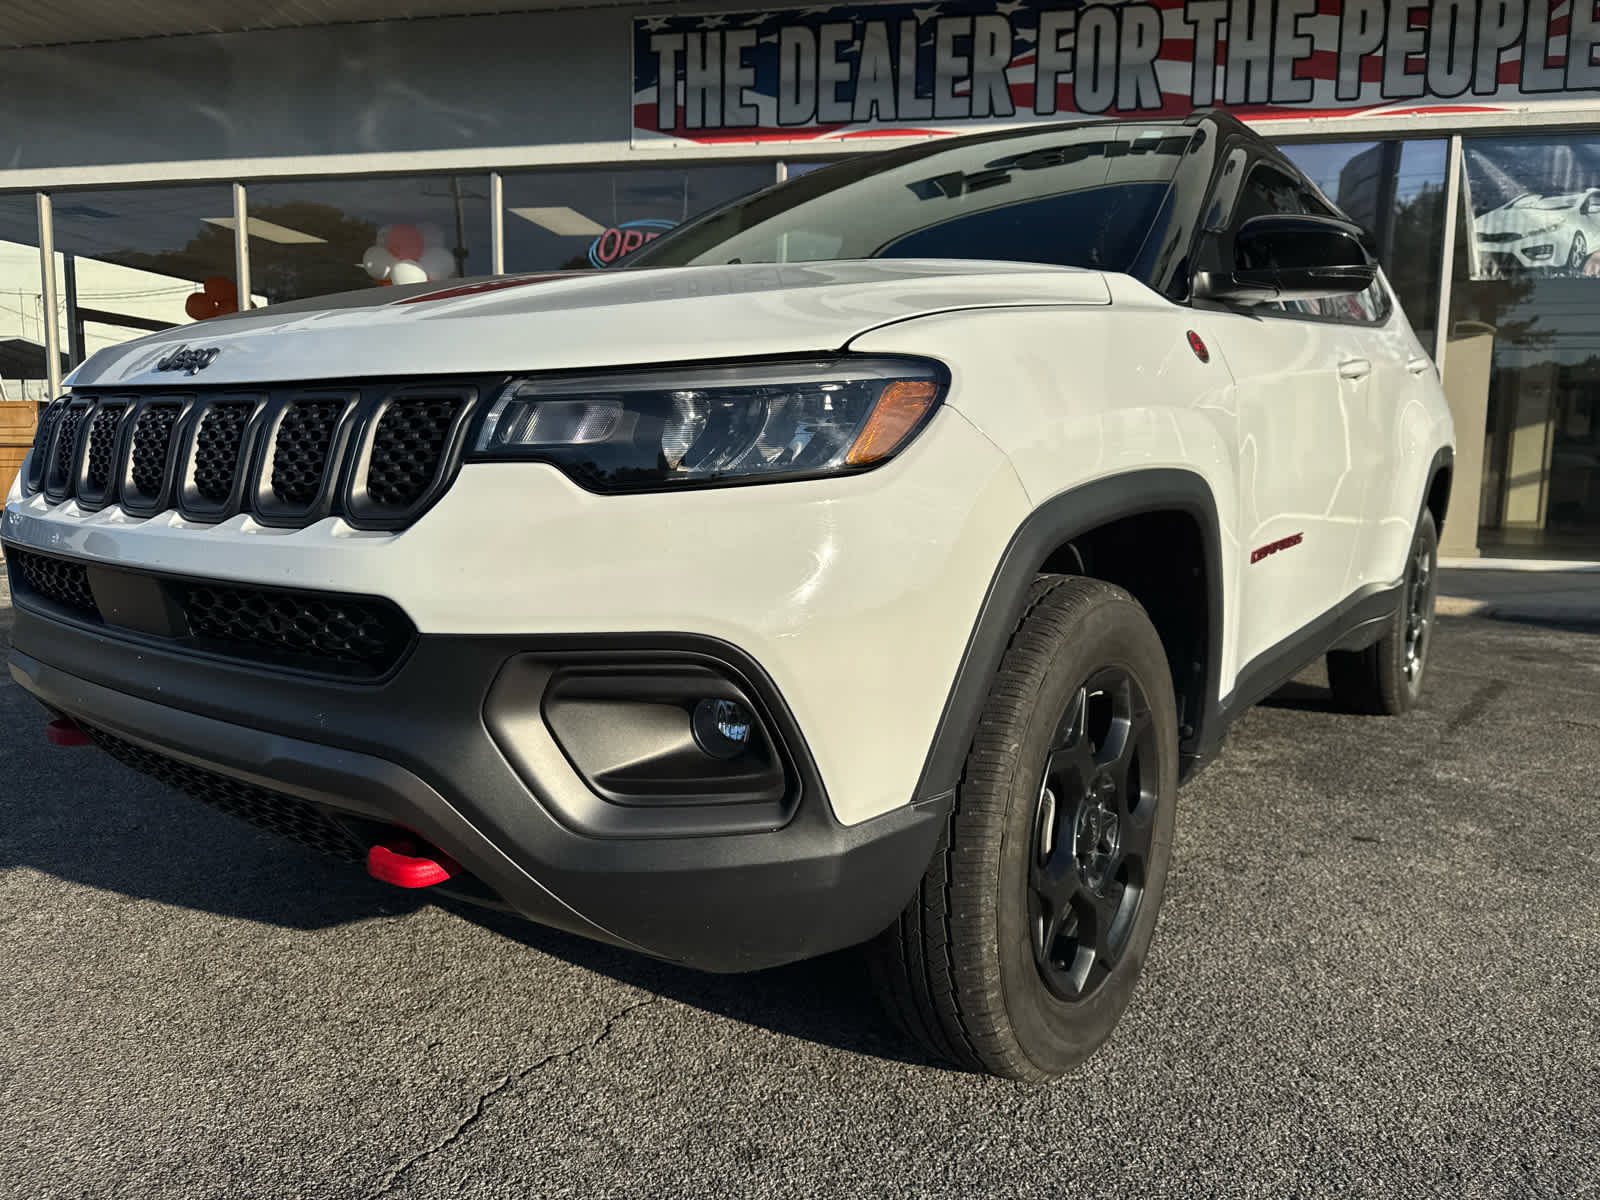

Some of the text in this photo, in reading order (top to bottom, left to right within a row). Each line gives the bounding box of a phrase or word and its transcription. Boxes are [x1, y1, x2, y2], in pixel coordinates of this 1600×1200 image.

[650, 0, 1600, 130] THE DEALER FOR THE PEOPLE
[157, 344, 220, 376] Jeep
